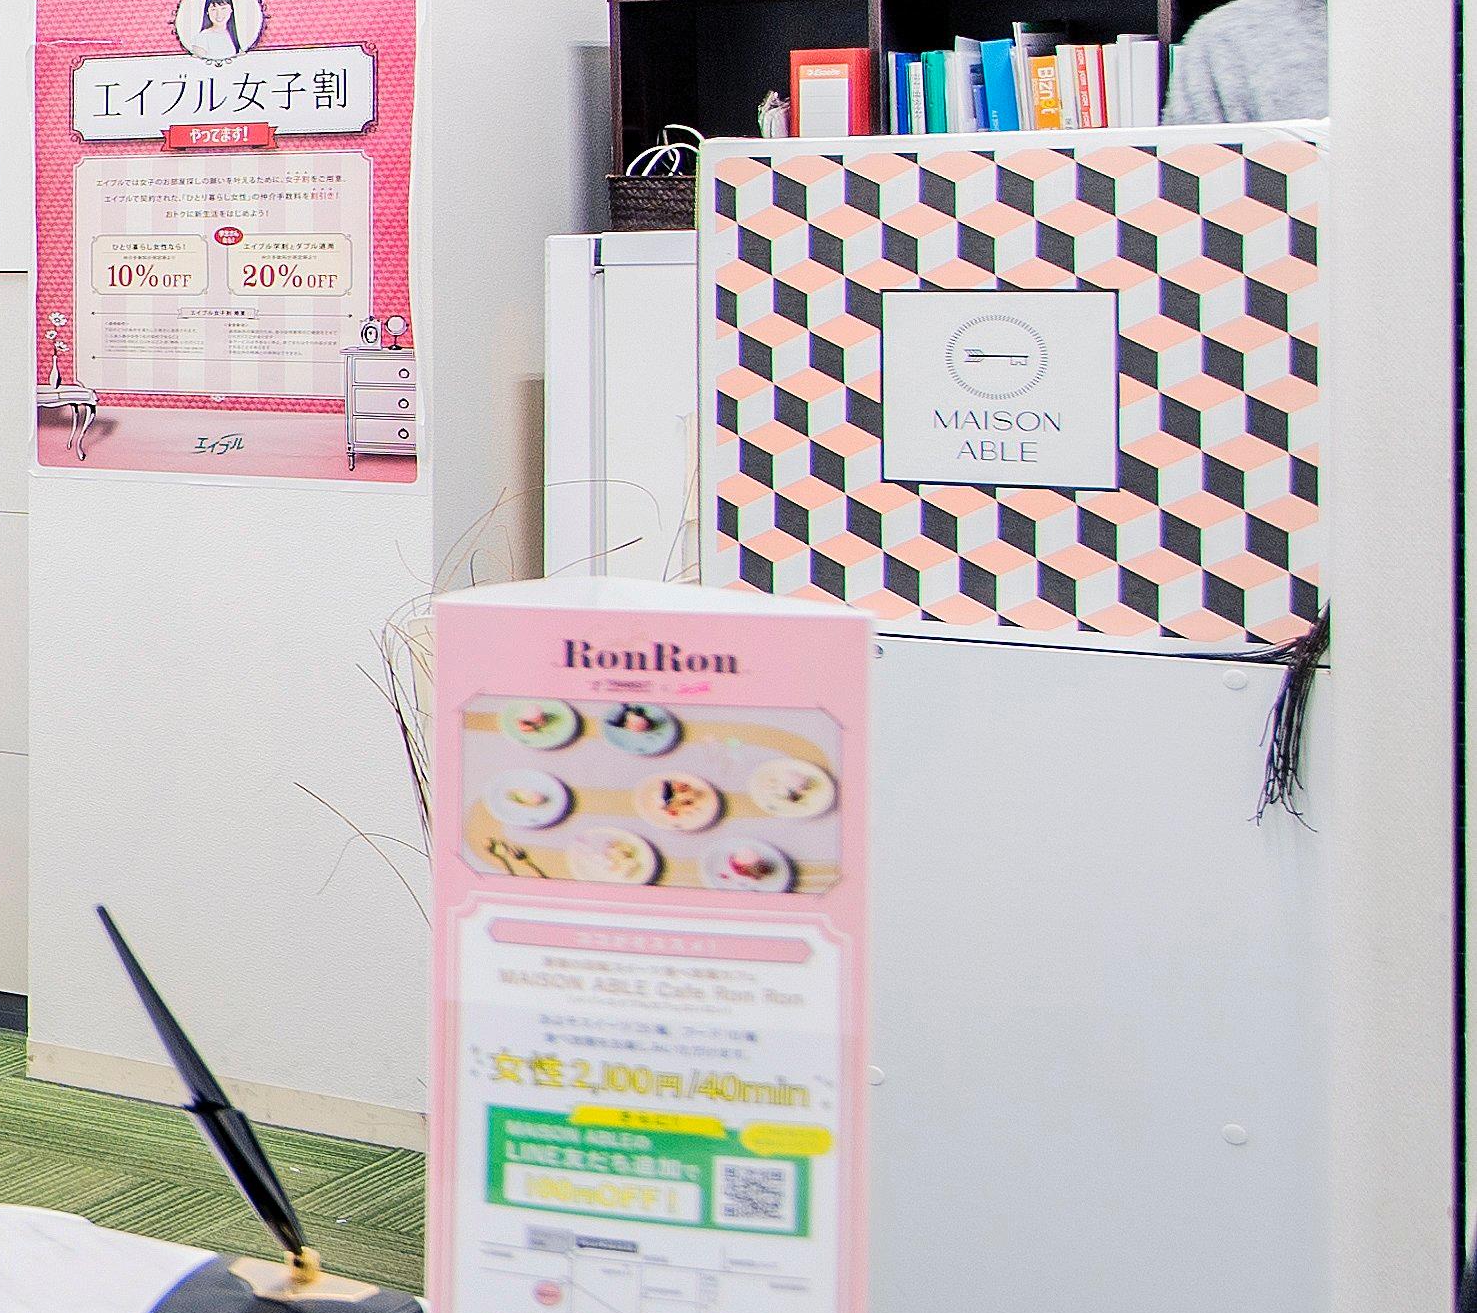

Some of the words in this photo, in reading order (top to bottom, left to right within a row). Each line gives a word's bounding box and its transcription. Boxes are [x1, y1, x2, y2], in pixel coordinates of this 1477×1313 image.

[93, 68, 348, 118] エイブル女子割
[108, 264, 159, 287] 10%
[163, 274, 192, 287] OFF
[243, 264, 303, 288] 20%
[307, 274, 338, 288] OFF
[934, 409, 1061, 432] MAISON
[957, 439, 1038, 463] ABLE
[563, 639, 739, 674] RonRon
